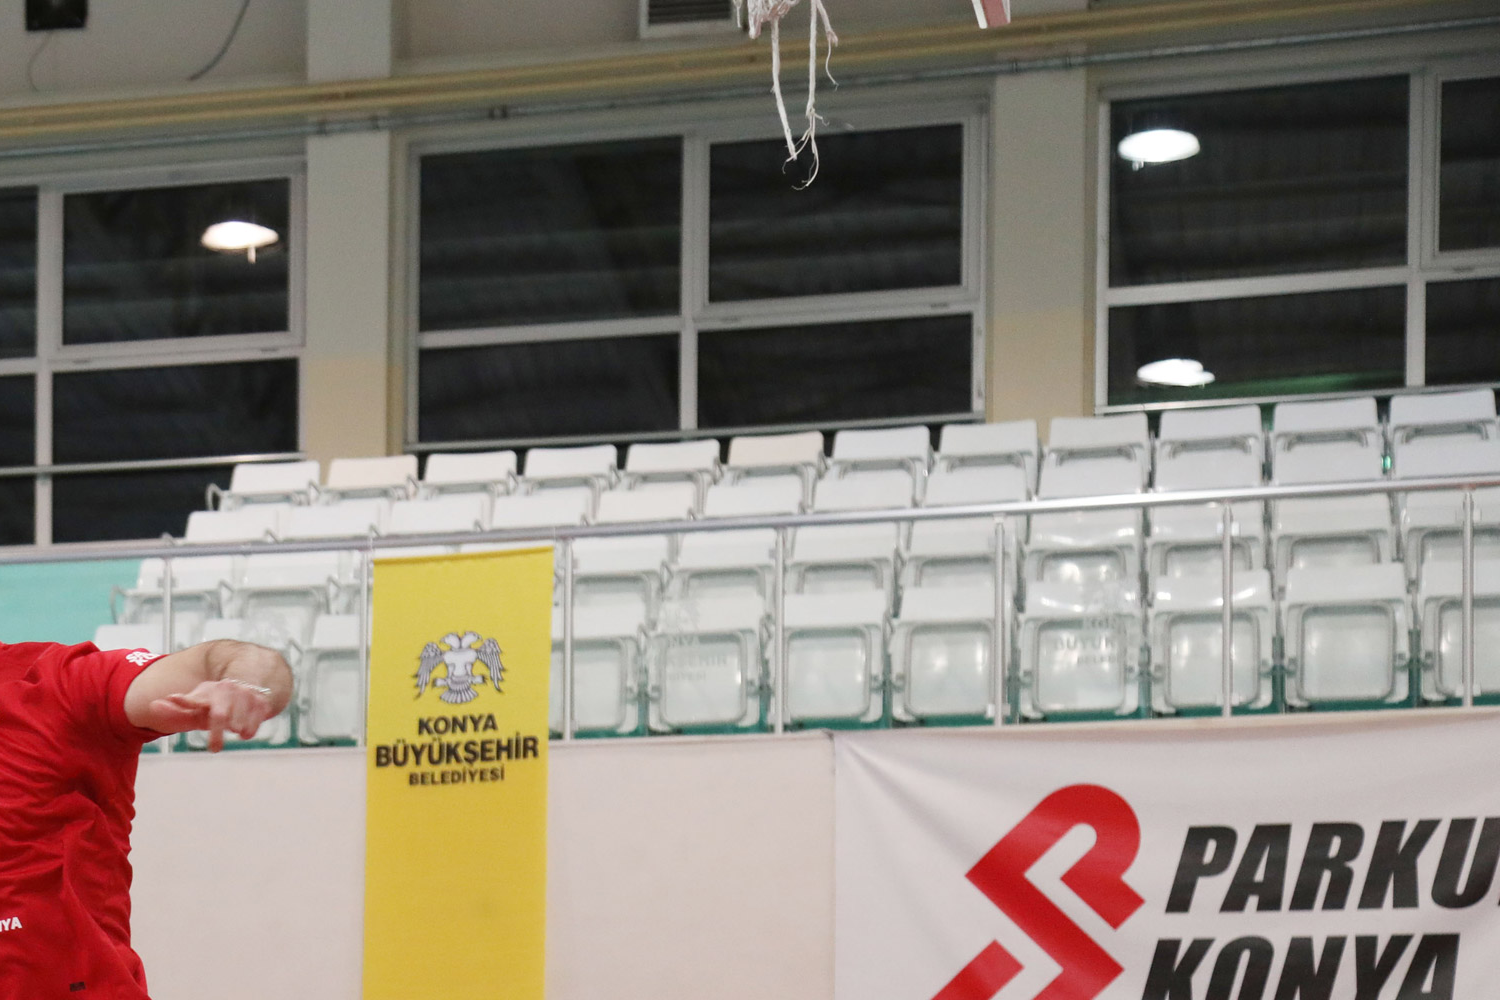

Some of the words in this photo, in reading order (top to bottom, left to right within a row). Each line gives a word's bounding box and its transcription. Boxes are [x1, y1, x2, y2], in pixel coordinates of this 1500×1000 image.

[418, 713, 498, 736] KONYA
[375, 731, 539, 768] BÜYÜKŞEHİR
[408, 765, 505, 786] BELEDİYESİ
[1165, 817, 1500, 914] PARKU
